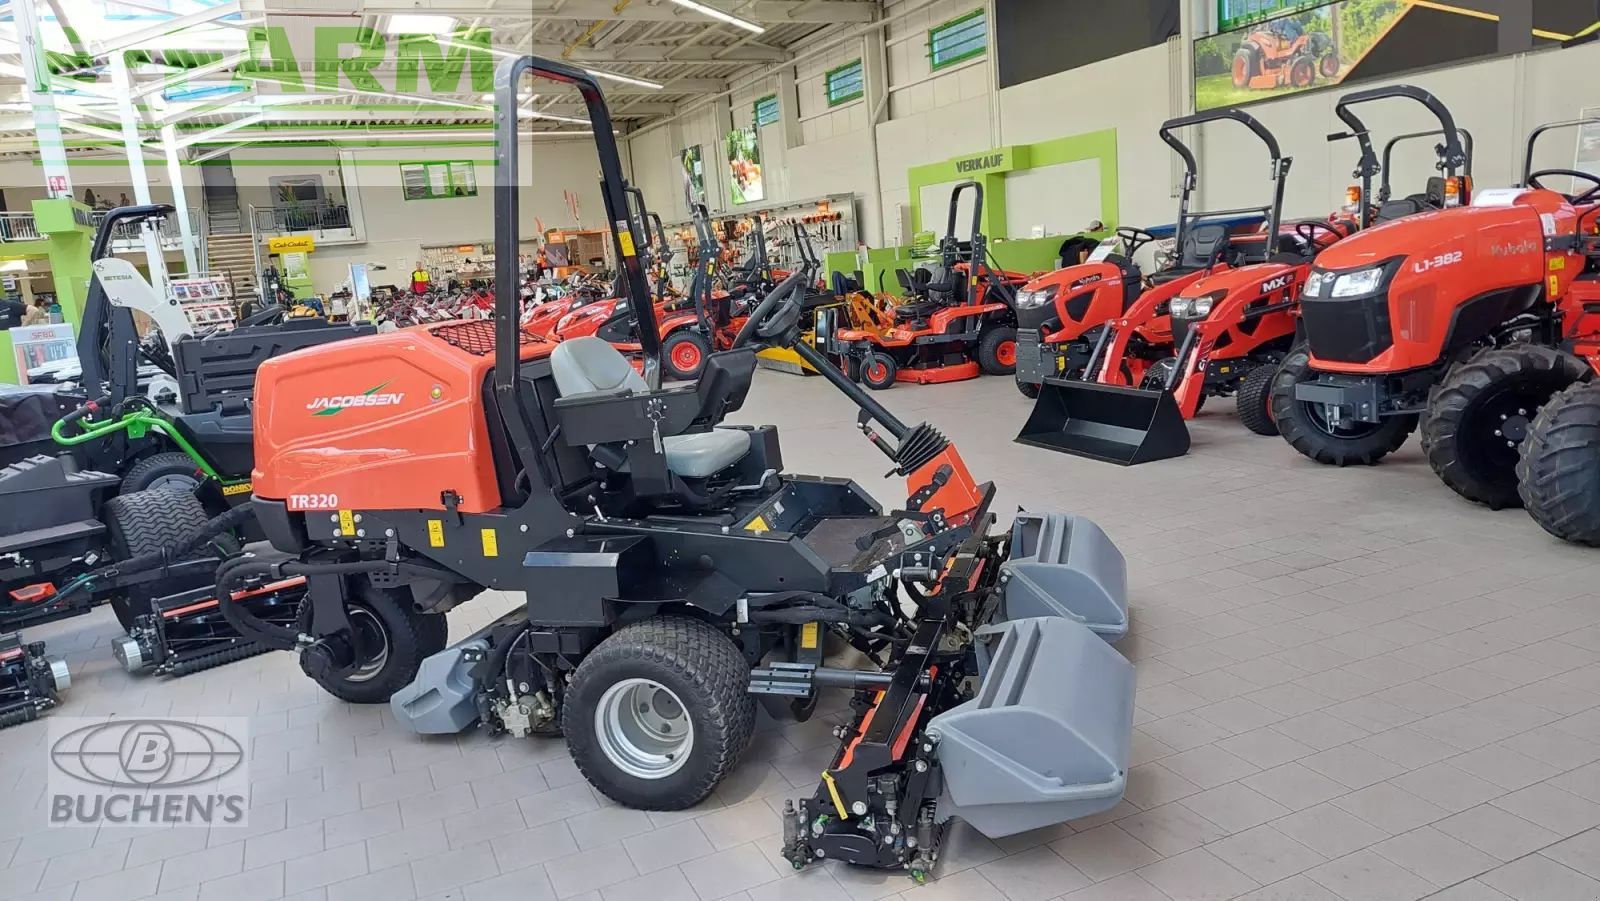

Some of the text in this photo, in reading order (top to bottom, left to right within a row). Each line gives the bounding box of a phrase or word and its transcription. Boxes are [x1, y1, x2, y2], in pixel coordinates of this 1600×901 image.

[955, 153, 1003, 173] VERKAUF
[1490, 239, 1537, 257] Kubota
[1413, 251, 1464, 273] L1-382
[1262, 276, 1286, 293] MX
[306, 393, 405, 410] JACOBSEN
[289, 494, 338, 509] TR320
